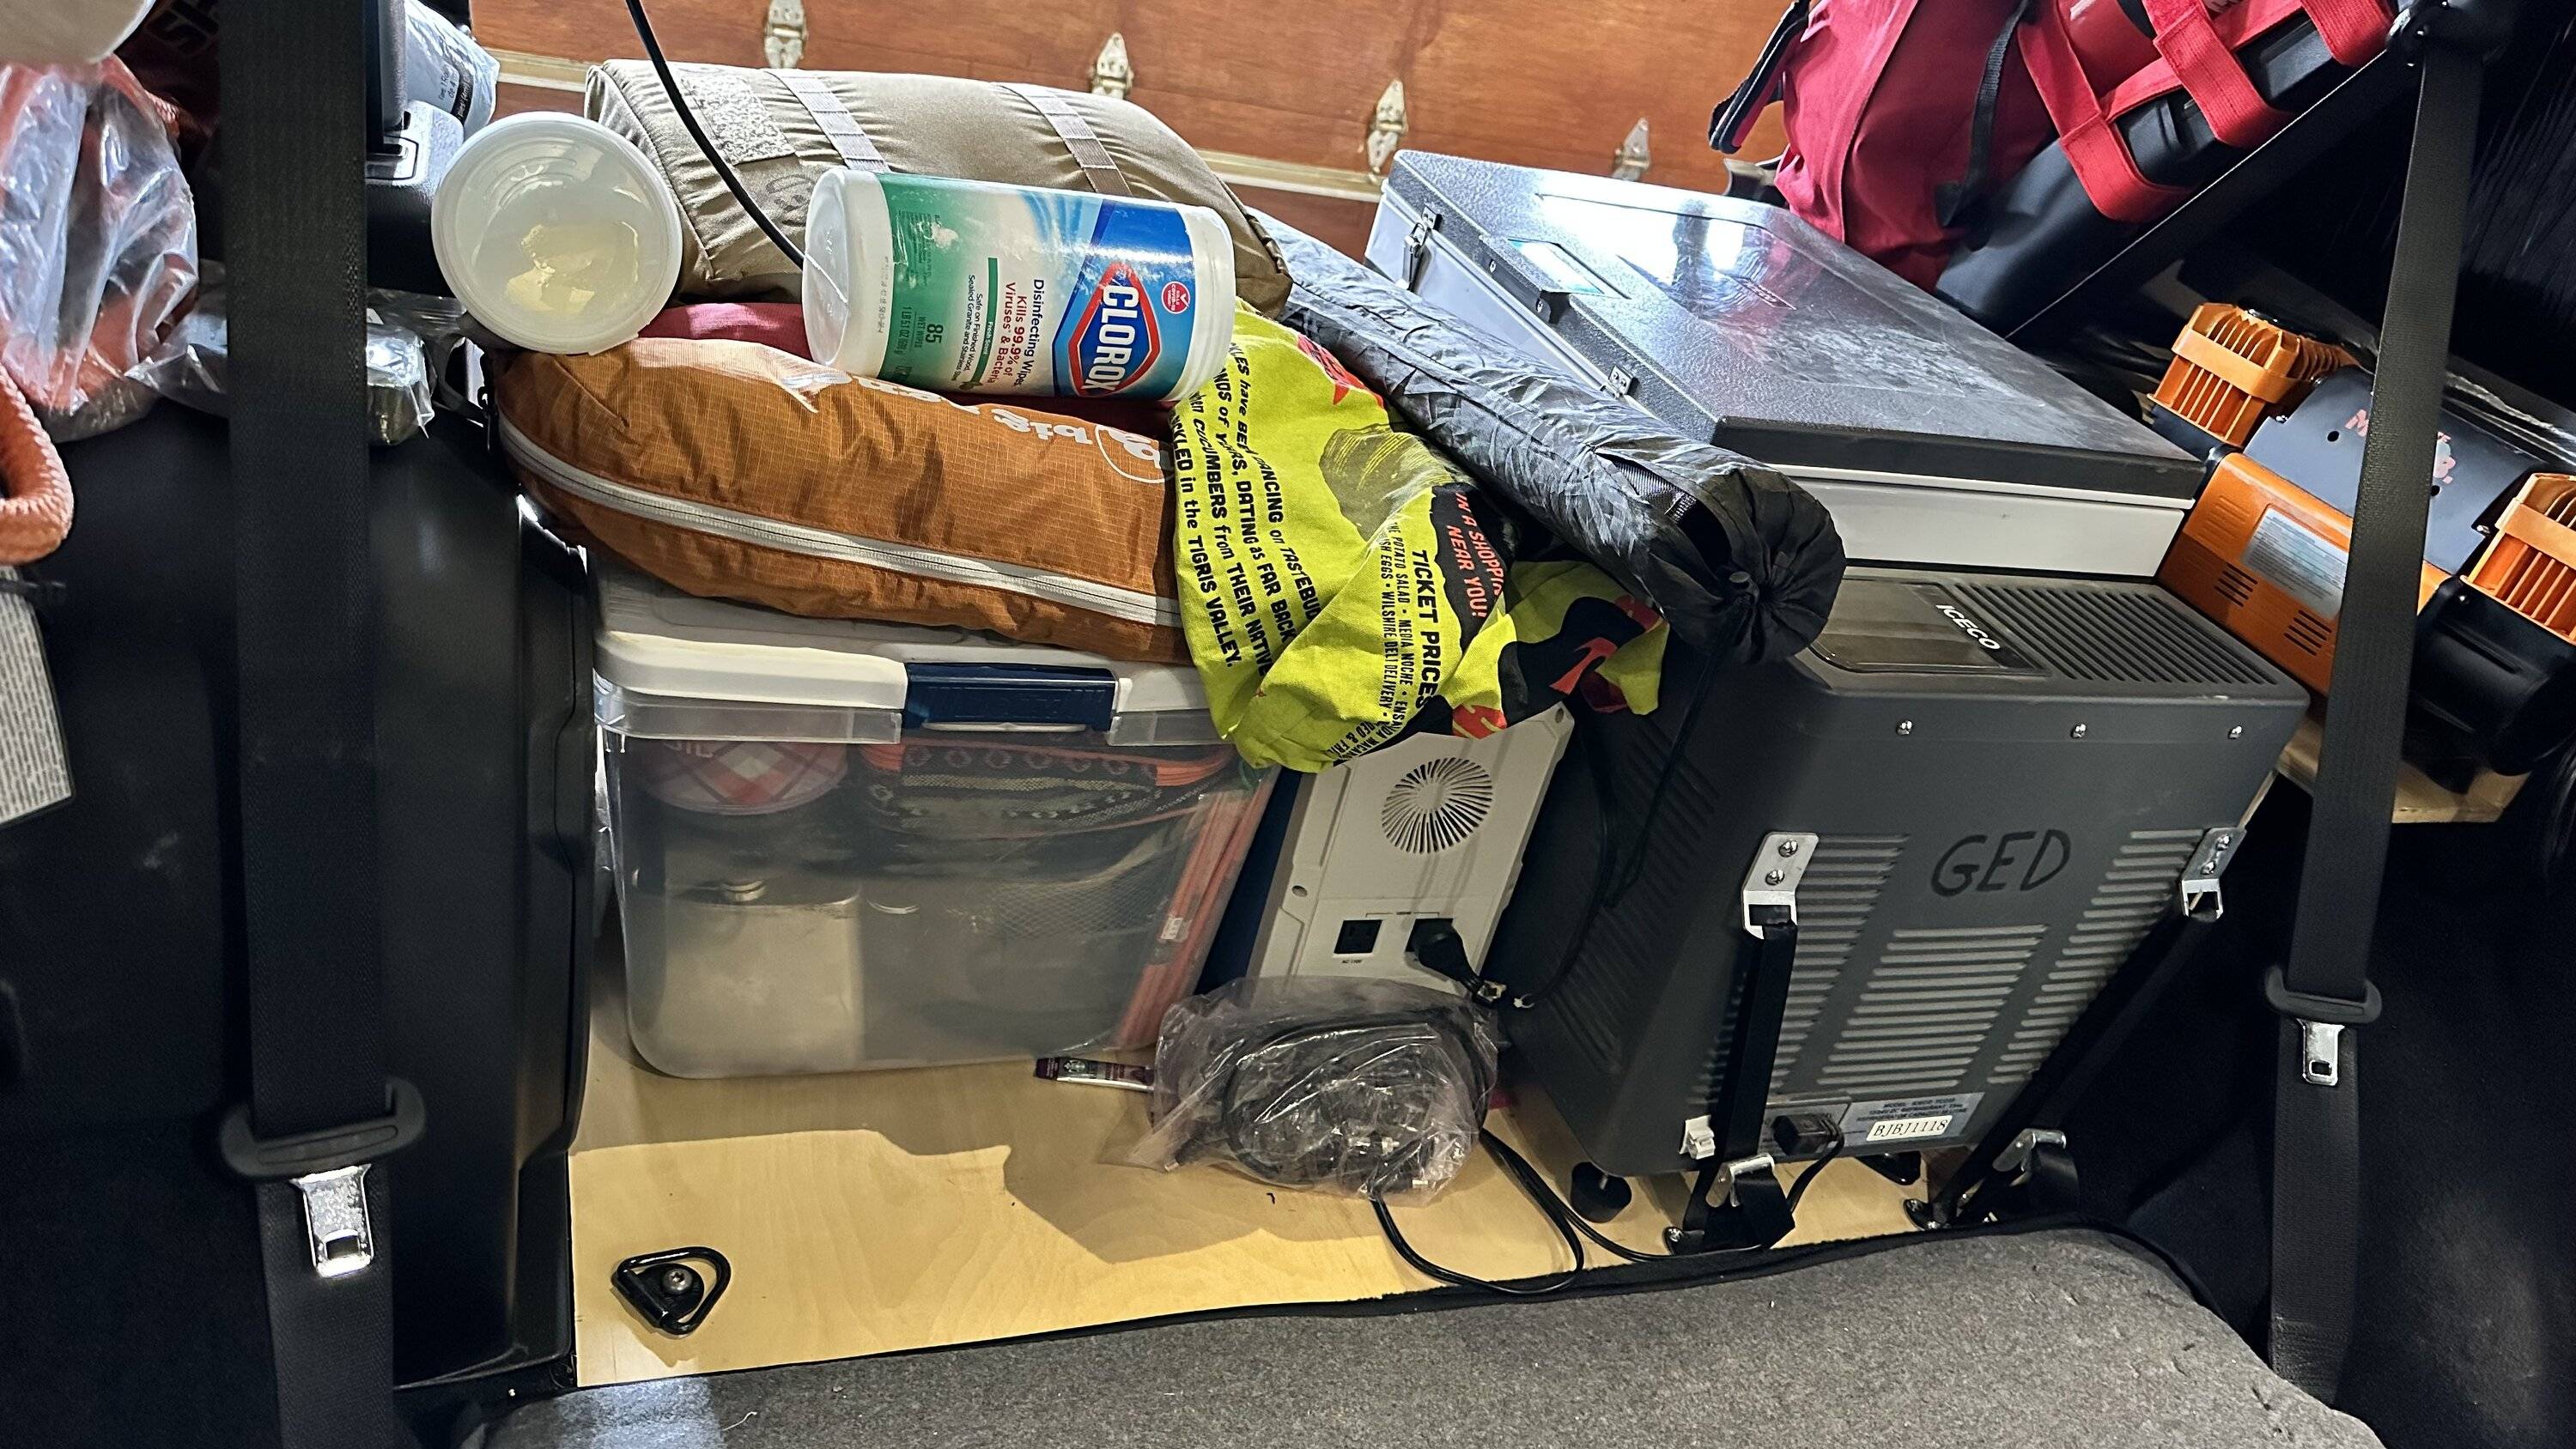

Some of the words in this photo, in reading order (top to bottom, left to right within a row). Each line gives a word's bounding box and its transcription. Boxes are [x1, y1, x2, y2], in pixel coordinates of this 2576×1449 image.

[917, 316, 927, 330] WET
[965, 302, 974, 330] Granite
[975, 312, 981, 321] on
[1015, 295, 1027, 323] Kills
[1024, 279, 1044, 357] Disinfecting
[925, 323, 944, 343] 85
[970, 323, 981, 352] Finished
[1000, 336, 1011, 344] &
[1008, 326, 1025, 364] 99.9%
[1081, 285, 1139, 391] CLOROX
[987, 348, 1008, 384] Bacteria
[1004, 366, 1013, 376] of
[1014, 360, 1034, 386] Wipes
[1213, 367, 1232, 402] NDS
[1218, 406, 1230, 428] of
[1180, 477, 1196, 494] in
[1239, 379, 1251, 416] have
[1269, 530, 1285, 545] on
[1279, 547, 1323, 621] TASTEBUD
[1184, 500, 1200, 529] the
[1193, 418, 1229, 519] CUCUMBERS
[1213, 524, 1235, 560] from
[1226, 562, 1256, 617] THEIR
[1236, 480, 1260, 544] DATING
[1455, 492, 1472, 513] IN
[1462, 515, 1477, 527] A
[1249, 547, 1266, 561] as
[1379, 537, 1392, 551] ISH
[1391, 536, 1406, 573] POTATO
[1188, 534, 1218, 594] TIGRIS
[1256, 562, 1282, 597] FAR
[1380, 555, 1394, 579] EGGS
[1446, 524, 1475, 572] NEAR
[1464, 576, 1488, 619] YOU!
[1468, 530, 1504, 597] SHOPPIN
[1395, 573, 1411, 603] SALAD
[1412, 549, 1439, 624] TICKET
[1205, 596, 1242, 668] VALLEY.
[1270, 598, 1297, 643] BACK
[1381, 591, 1397, 642] WILSHIRE
[1935, 604, 2001, 650] ICECO
[1399, 619, 1413, 649] MEDIA
[1383, 641, 1399, 666] DELI
[1399, 652, 1415, 687] NOCHE
[1414, 631, 1442, 709] PRICES
[1378, 665, 1398, 714] DELIVERY
[1346, 734, 1359, 744] &
[1931, 828, 2071, 897] GED
[1873, 1119, 1948, 1137] BJBJ1118
